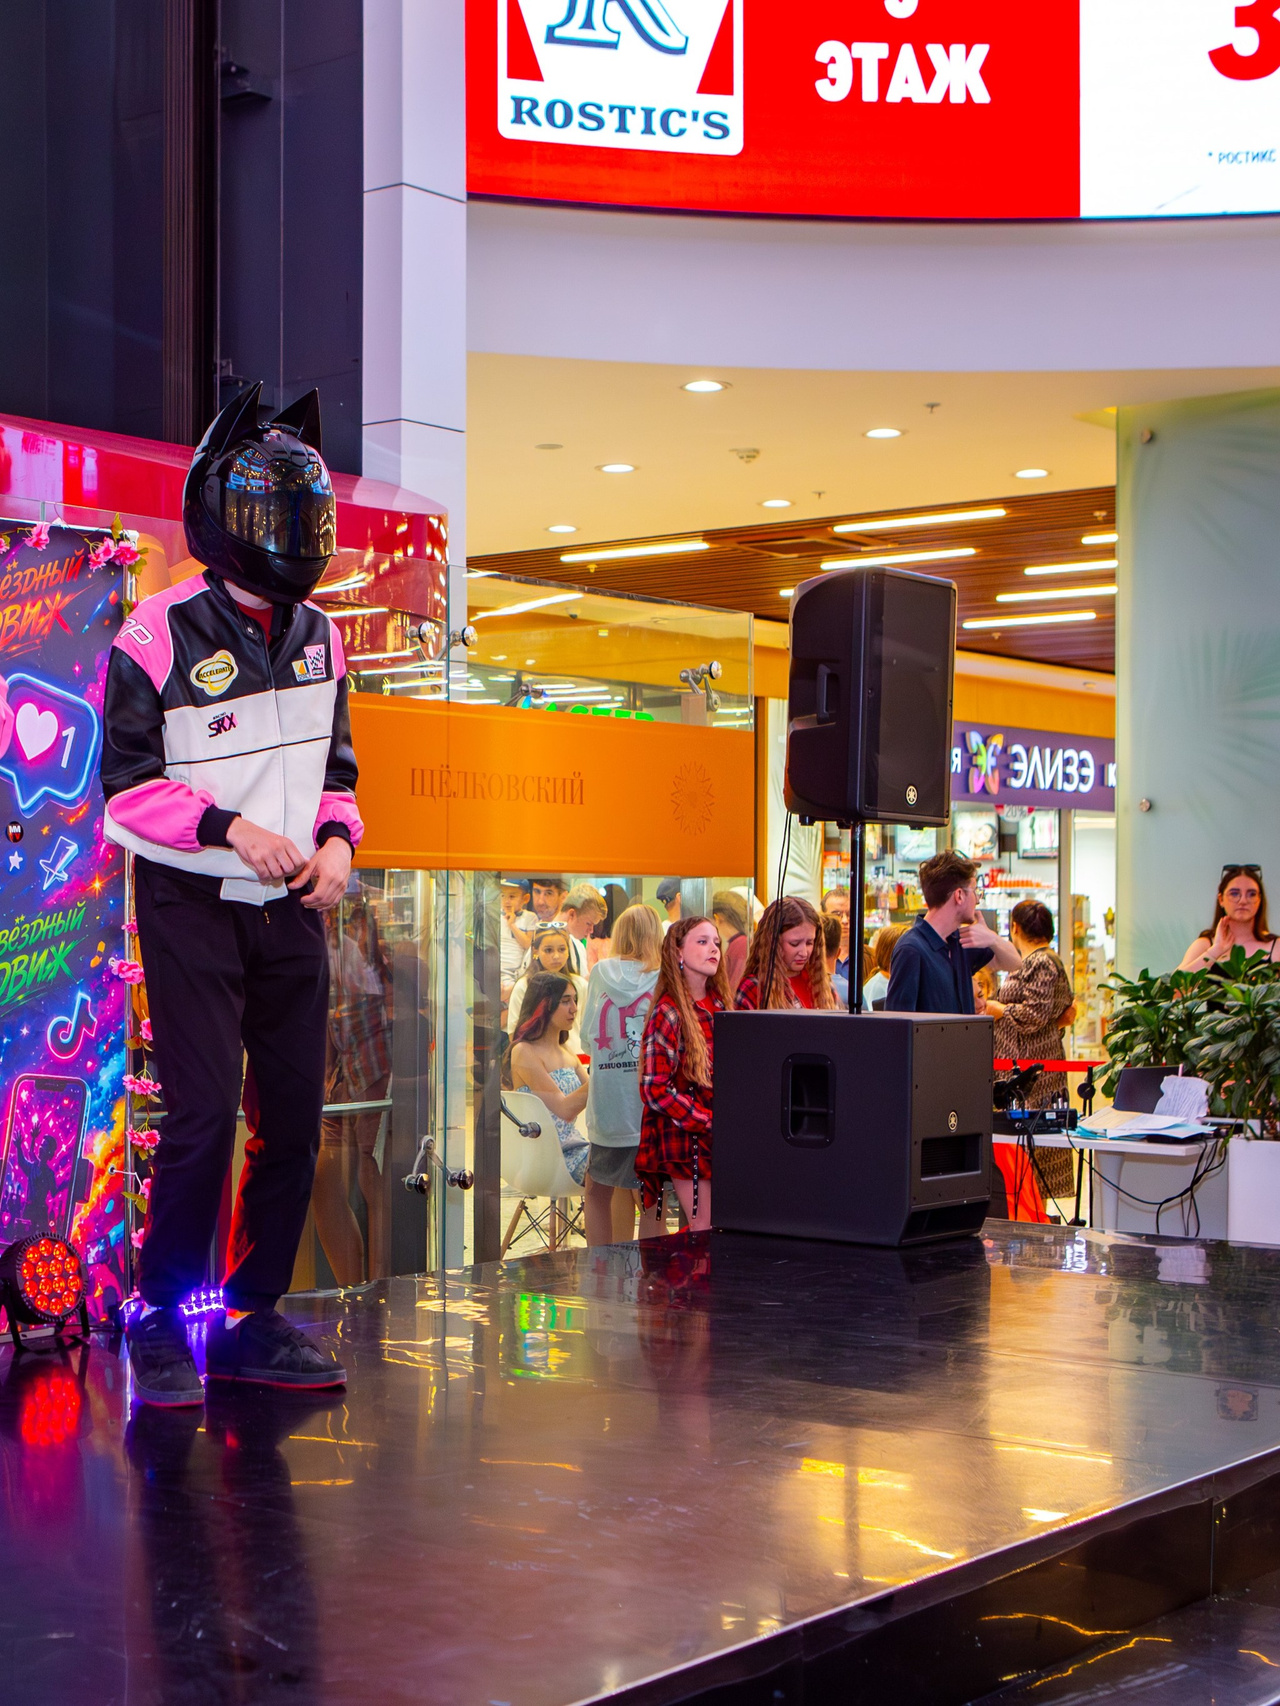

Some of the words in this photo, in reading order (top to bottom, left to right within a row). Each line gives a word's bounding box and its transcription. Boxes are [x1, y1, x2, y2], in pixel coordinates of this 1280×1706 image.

[814, 40, 991, 104] ЭТАЖ
[510, 95, 730, 140] ROSTIC'S
[1218, 148, 1276, 164] РОСТИКС
[410, 764, 585, 805] ЩЁЛКОВСКИЙ
[1008, 744, 1095, 793] ЭЛИЗЭ
